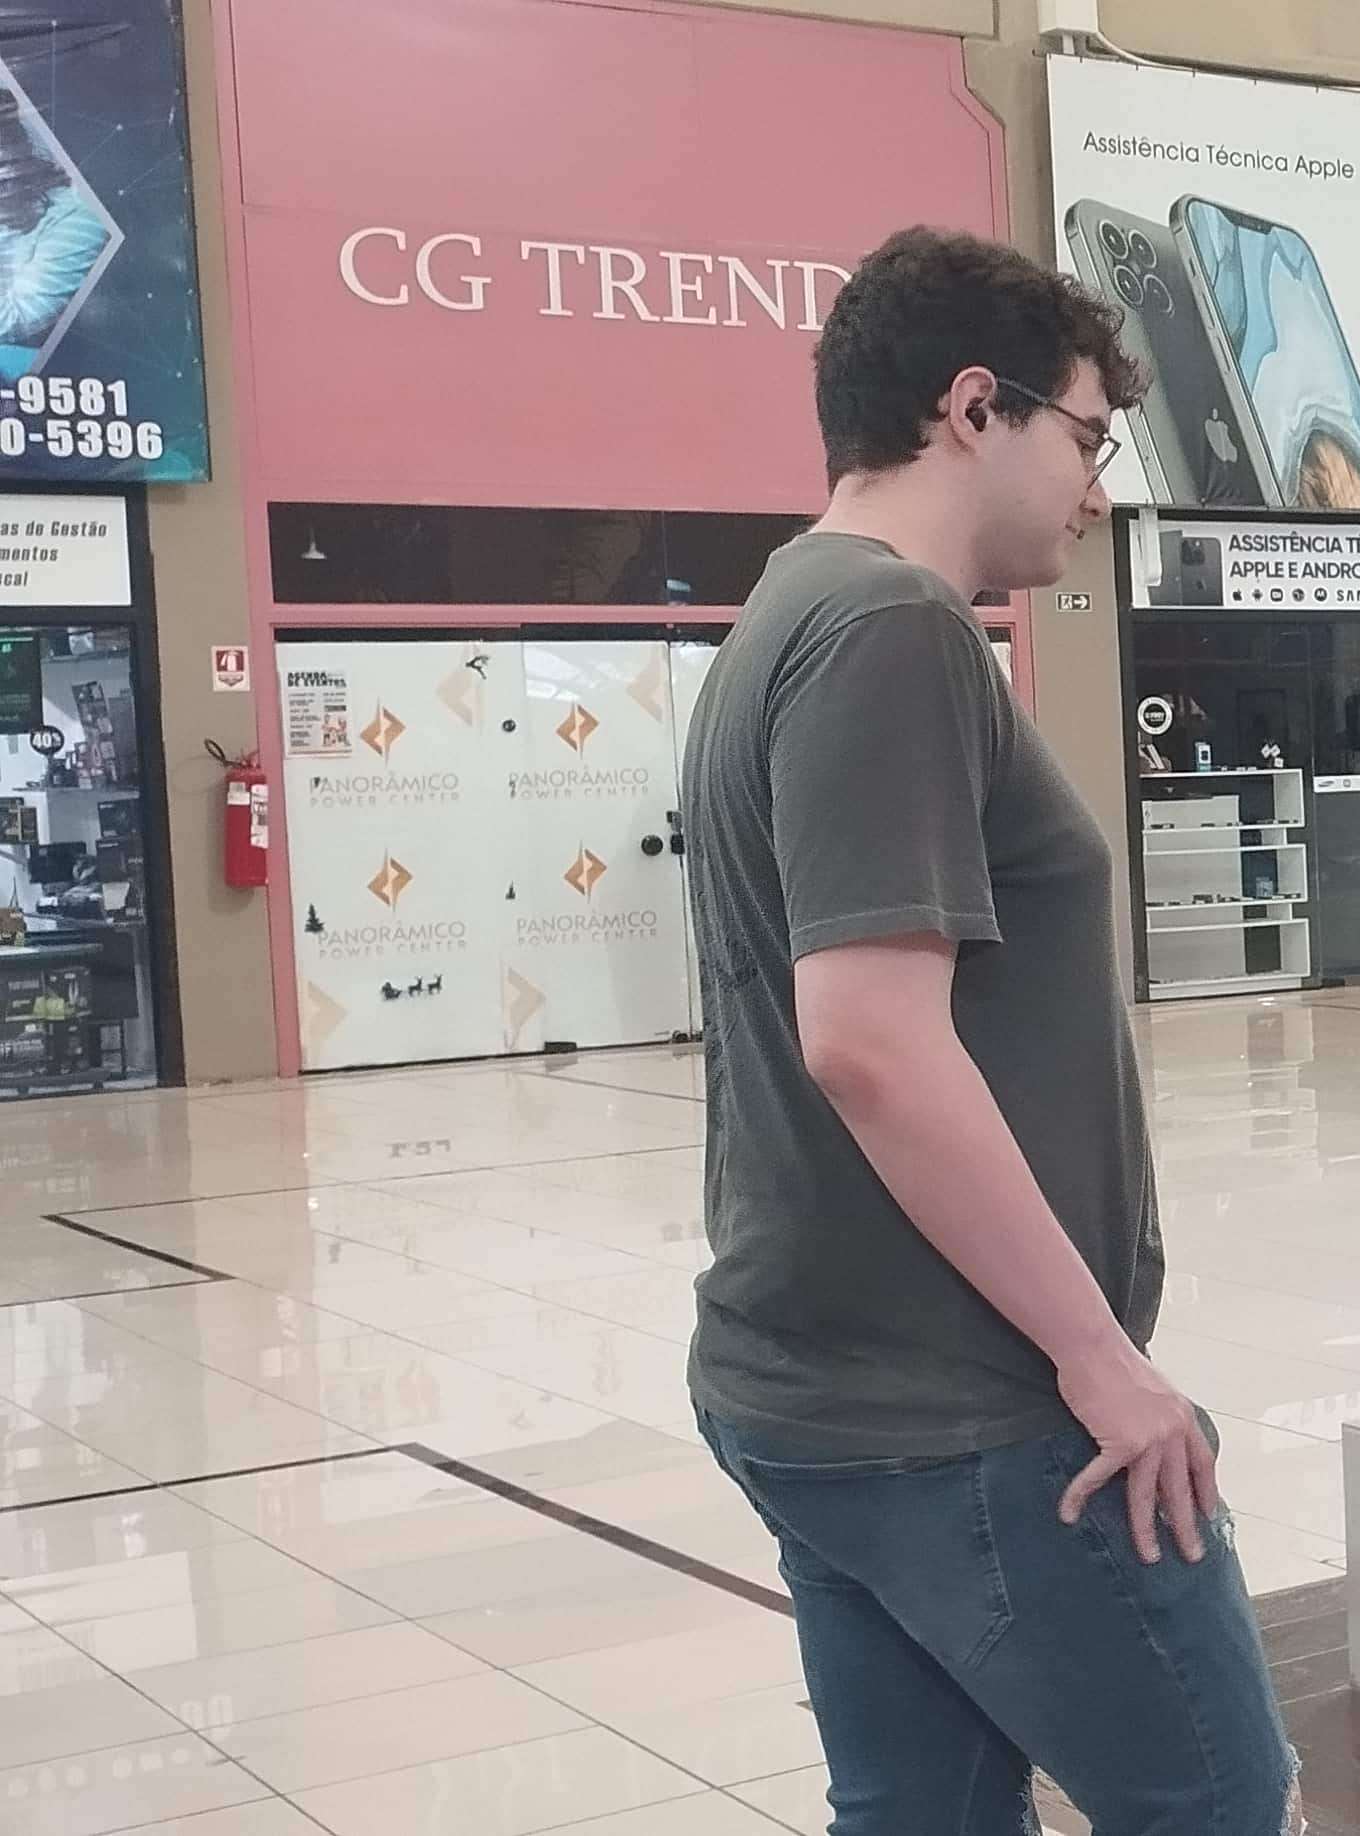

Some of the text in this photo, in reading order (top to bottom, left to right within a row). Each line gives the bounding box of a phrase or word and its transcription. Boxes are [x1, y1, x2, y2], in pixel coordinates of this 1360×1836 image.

[1083, 131, 1355, 181] Assistência Técnica Apple
[338, 227, 492, 311] CG
[26, 521, 45, 536] de
[51, 520, 107, 537] Gestão
[1229, 531, 1342, 553] ASSISTÊNCIA
[1229, 561, 1284, 578] APPLE
[1288, 562, 1298, 578] E
